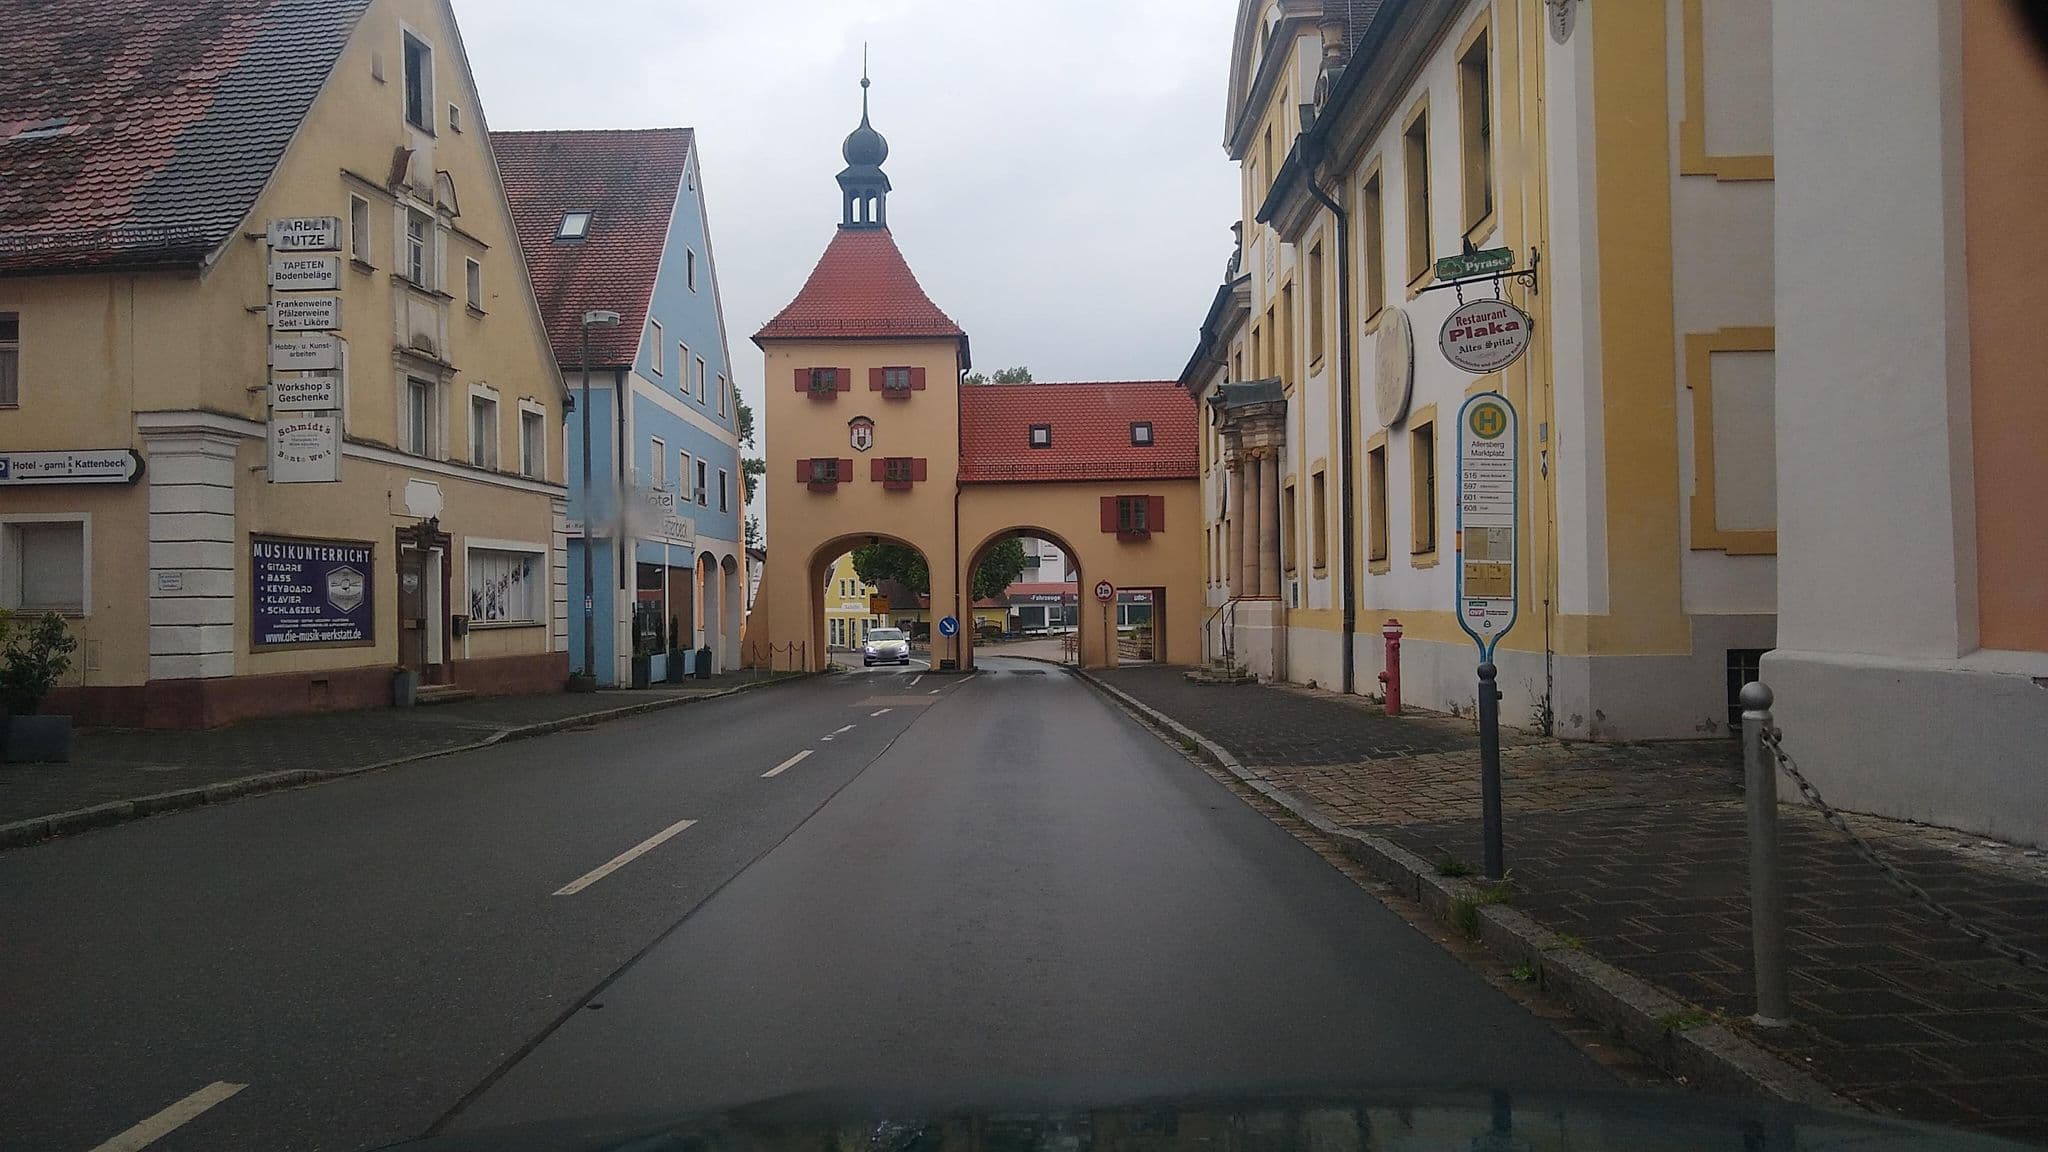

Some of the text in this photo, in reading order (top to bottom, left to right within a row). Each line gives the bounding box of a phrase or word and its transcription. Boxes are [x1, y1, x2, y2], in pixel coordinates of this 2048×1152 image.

[283, 261, 324, 269] TAPETEN
[275, 271, 332, 280] Bodenbeläge
[276, 300, 332, 309] Frankenweine
[1456, 309, 1507, 326] Restaurant
[279, 319, 297, 327] Sekt
[1449, 321, 1520, 342] Plaka
[309, 343, 332, 351] Kunst-
[279, 394, 329, 403] Geschenke
[1479, 412, 1497, 430] H
[1471, 441, 1505, 450] Allersberg
[1471, 449, 1505, 458] Marktplatz
[12, 462, 36, 470] Hotel
[44, 460, 66, 471] garni
[75, 459, 126, 468] Kattenbeck
[253, 543, 370, 562] MUSIKUNTERRICHT
[267, 563, 302, 572] GITARRE
[267, 574, 291, 582] BASS
[267, 585, 312, 593] KEYBOARD
[267, 596, 302, 604] KLAVIER
[267, 606, 320, 614] SCHLAGZEUG
[265, 628, 361, 642] www.die-musik-werkstatt.de
